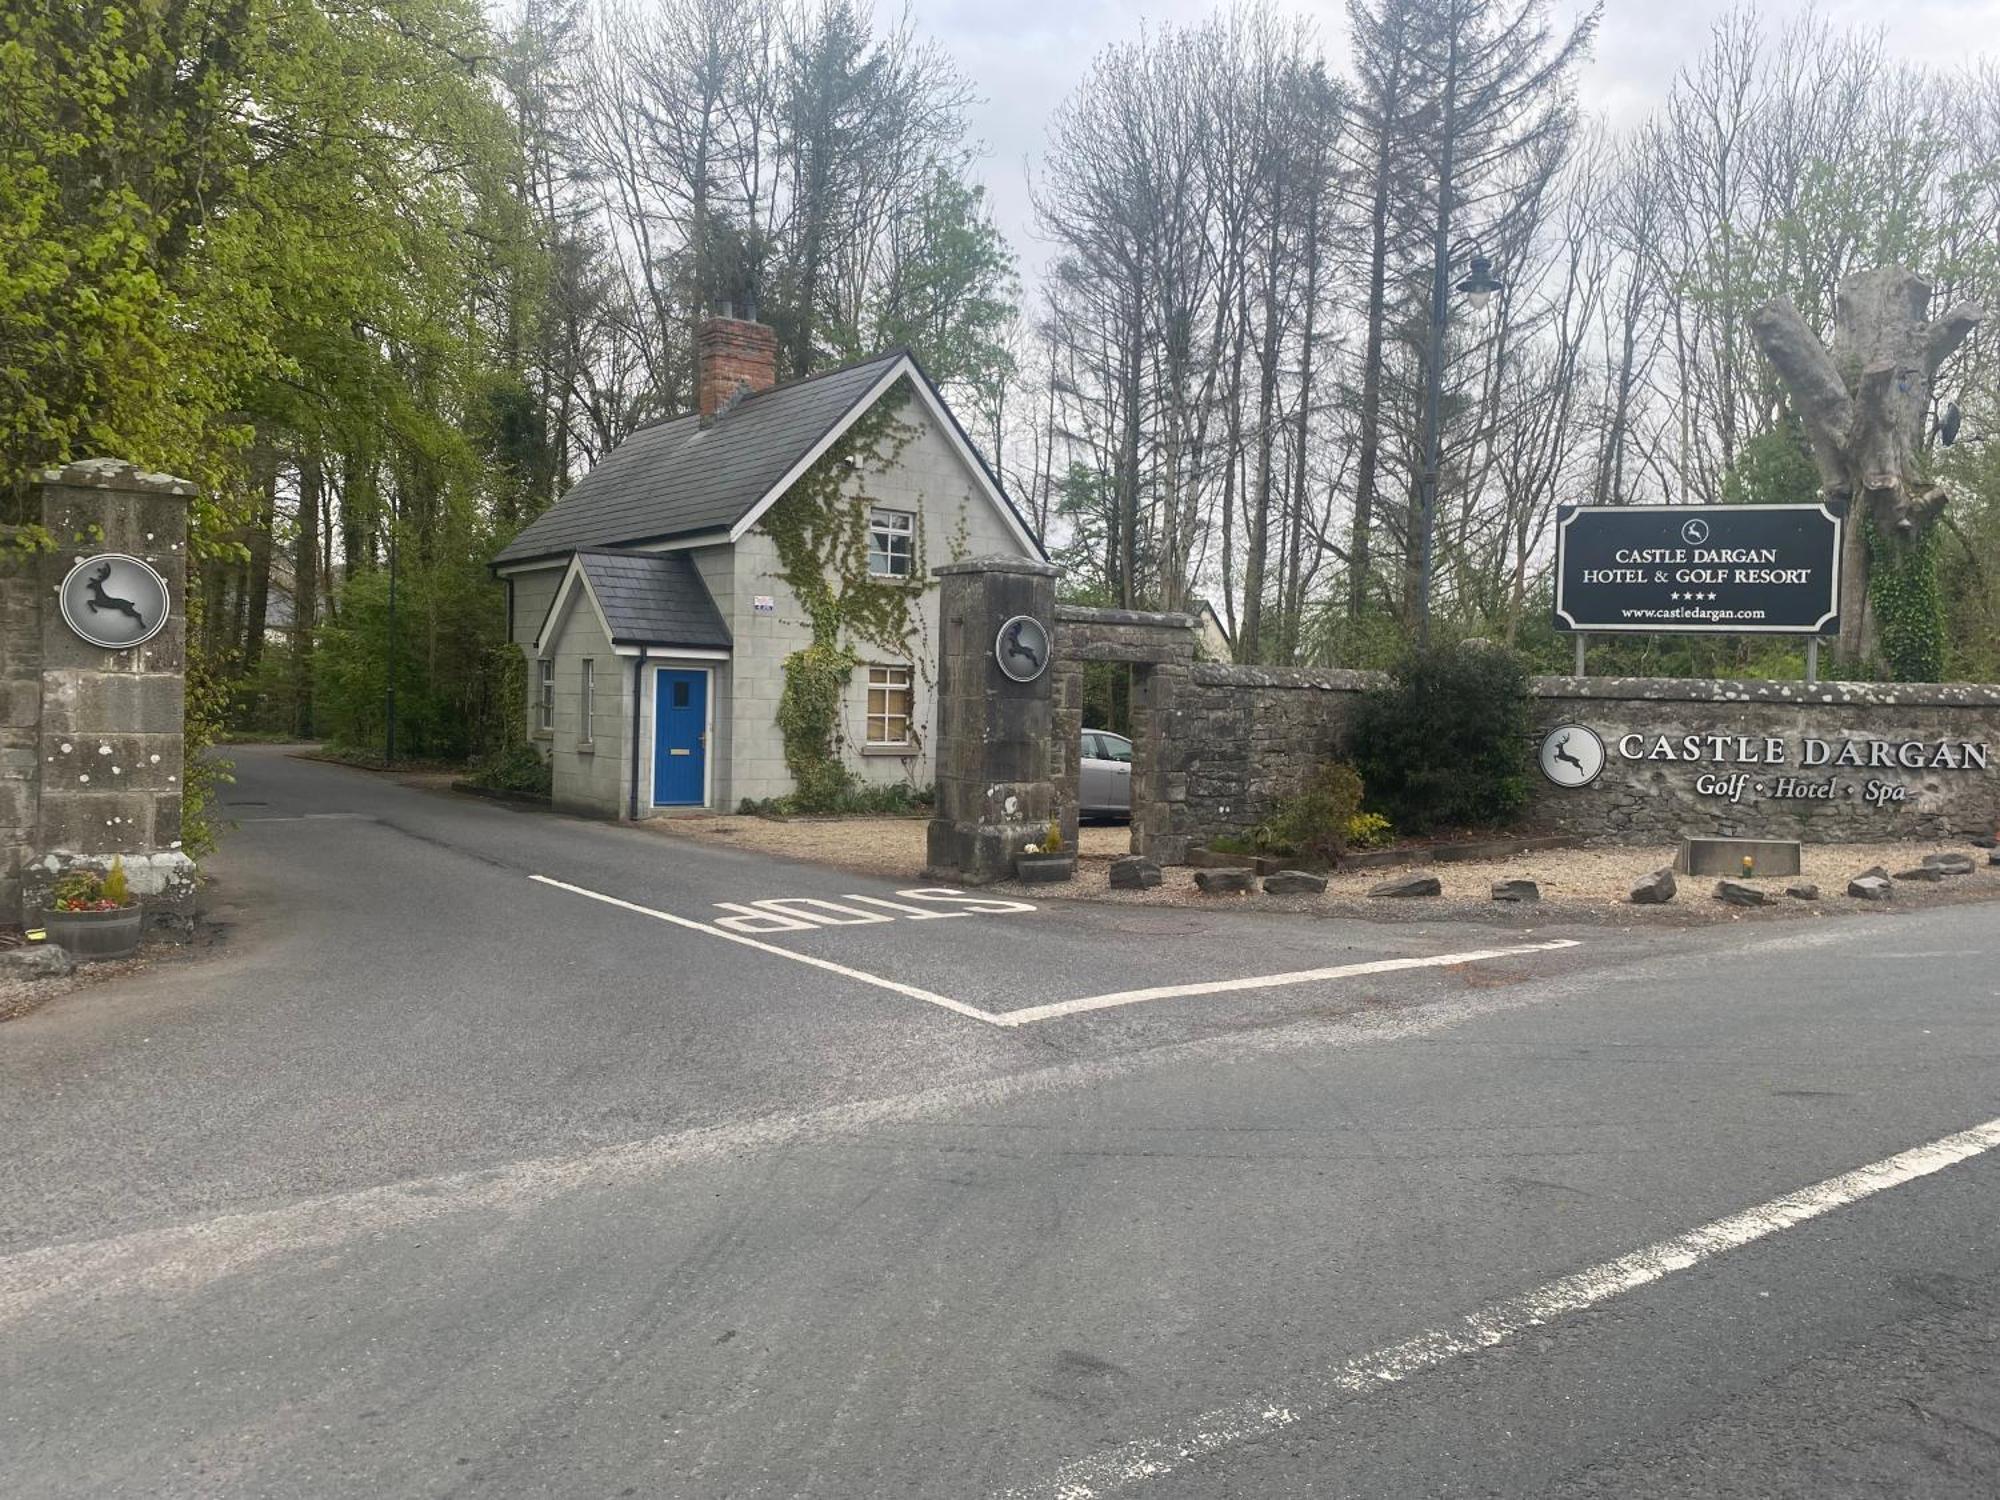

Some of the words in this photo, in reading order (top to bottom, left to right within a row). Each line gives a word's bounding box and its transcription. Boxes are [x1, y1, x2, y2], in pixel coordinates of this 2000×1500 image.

[1615, 549, 1687, 564] CASTLE
[1692, 549, 1777, 564] DARGAN
[1582, 569, 1648, 584] HOTEL
[1654, 571, 1669, 584] &
[1675, 569, 1729, 584] GOLF
[1733, 569, 1812, 585] RESORT
[1622, 607, 1766, 622] www.castledargan.com
[1619, 733, 1786, 763] CASTLE
[1802, 739, 1991, 769] DARGAN
[1696, 774, 1749, 802] Golf
[1774, 777, 1837, 799] Hotel
[1865, 779, 1906, 807] Spa
